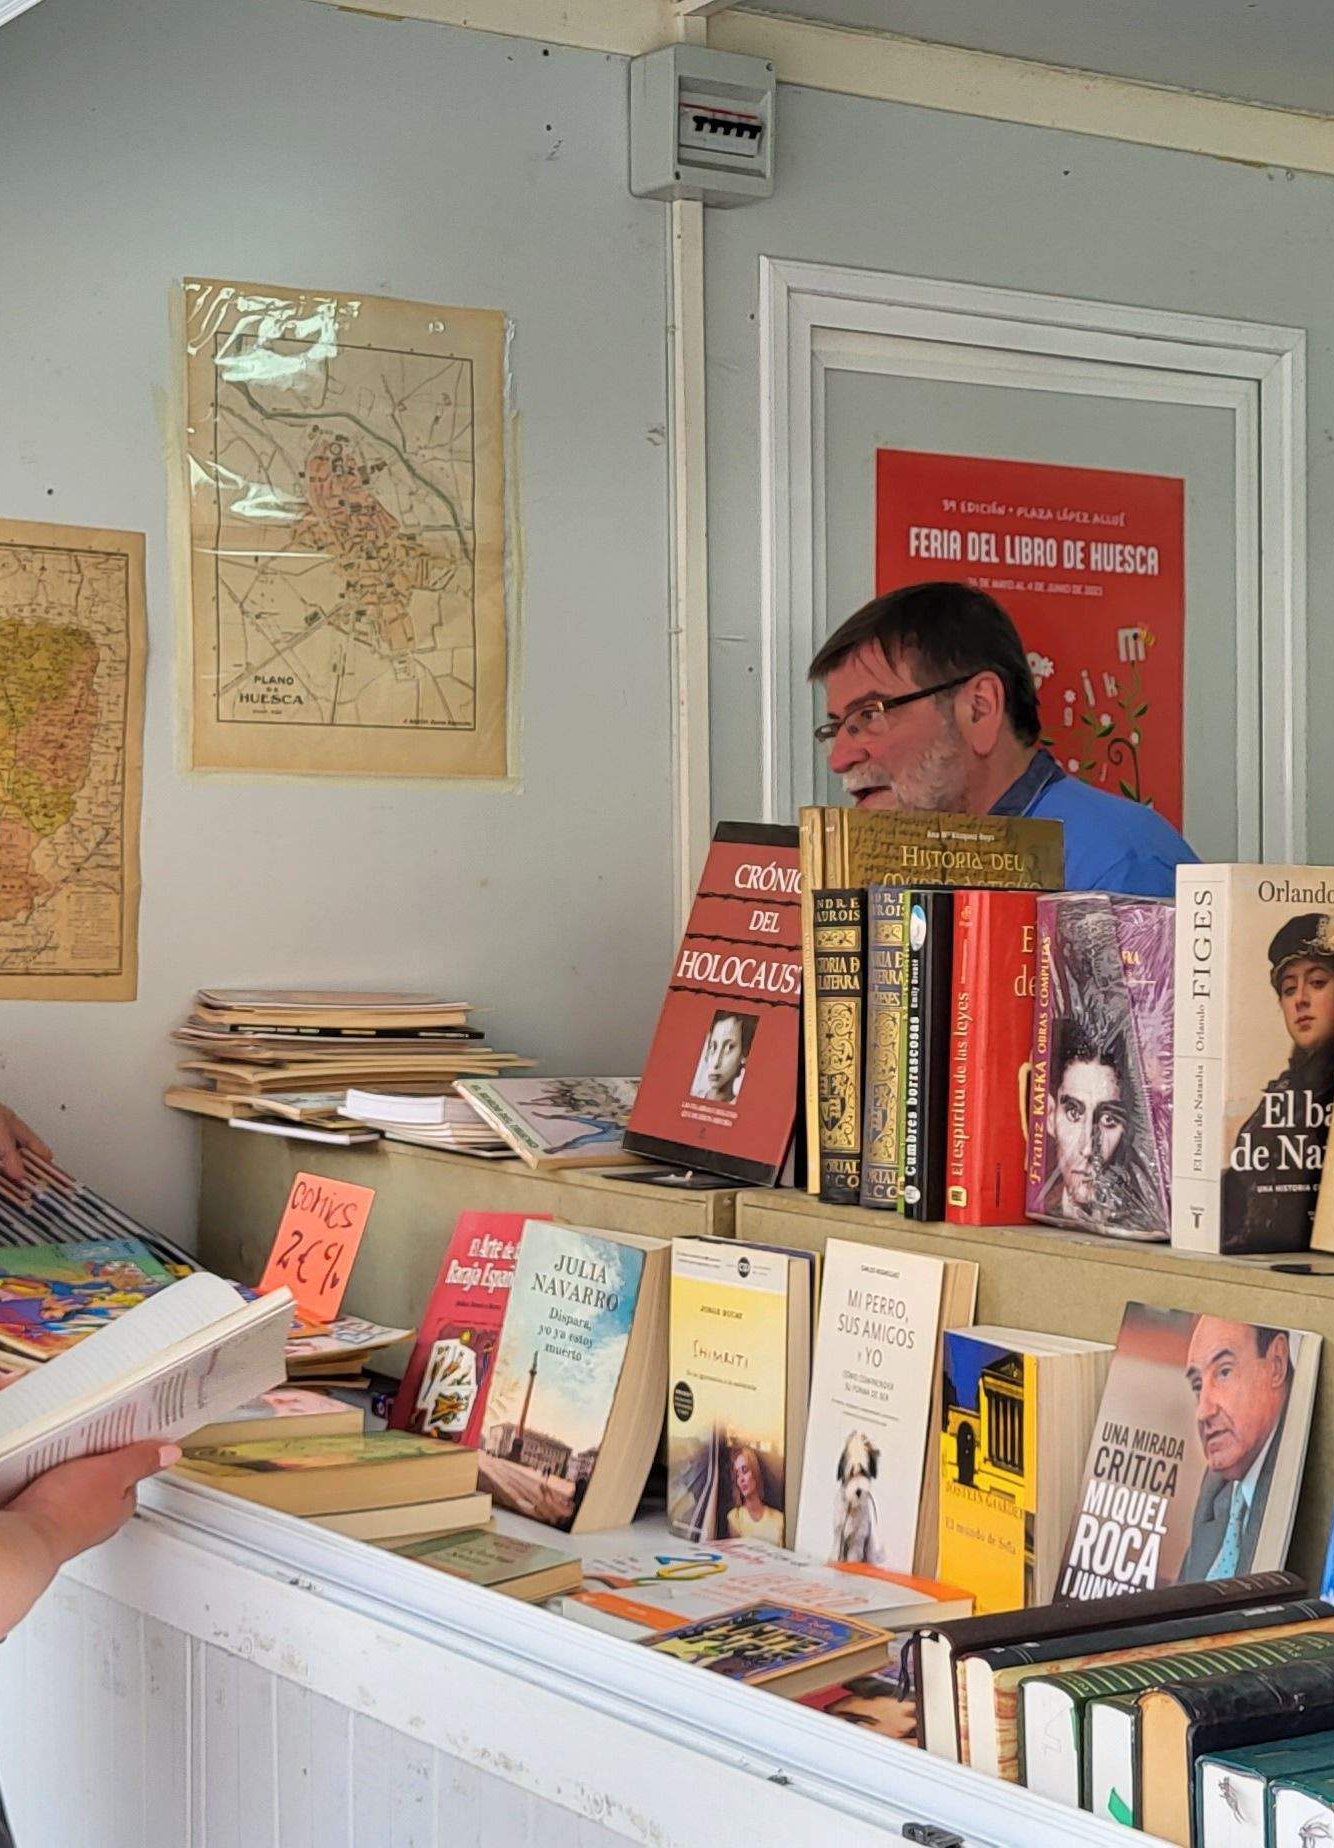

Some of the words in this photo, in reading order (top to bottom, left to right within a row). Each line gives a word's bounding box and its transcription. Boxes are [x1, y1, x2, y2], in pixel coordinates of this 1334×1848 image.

[960, 501, 1006, 516] EDICIÓN
[1017, 507, 1054, 520] PLAZA
[1056, 507, 1090, 524] LÓPEZ
[909, 526, 962, 560] FERIA
[967, 531, 1000, 564] DEL
[1004, 535, 1057, 568] LIBRO
[1063, 540, 1085, 570] DE
[1090, 542, 1159, 576] HUESCA
[254, 675, 295, 686] PLANO
[238, 693, 304, 705] HUESCA
[900, 845, 984, 870] HISTORIA
[991, 852, 1026, 873] DEL
[734, 861, 802, 894] CRÓNIC
[749, 910, 780, 933] DEL
[1193, 890, 1214, 999] FIGES
[910, 986, 920, 1008] Emily
[954, 992, 973, 1037] leyes
[1195, 1004, 1206, 1052] Orlando
[1037, 1012, 1049, 1054] OBRAS
[907, 1016, 920, 1105] borrascosas
[955, 1041, 968, 1061] las
[957, 1066, 967, 1084] de
[1032, 1061, 1048, 1115] KAFKA
[1194, 1065, 1205, 1110] Natasha
[1194, 1113, 1204, 1127] de
[1261, 1089, 1295, 1128] El
[904, 1111, 918, 1177] Cumbres
[1030, 1122, 1045, 1185] Franz
[1193, 1130, 1204, 1156] baile
[1229, 1133, 1270, 1171] de
[952, 1162, 964, 1177] El
[1193, 1160, 1203, 1172] El
[1257, 1184, 1274, 1193] UNA
[1275, 1184, 1311, 1193] HISTORIA
[480, 1233, 503, 1260] Arte
[502, 1240, 516, 1260] de
[445, 1258, 482, 1292] Baraja
[554, 1254, 608, 1285] JULIA
[531, 1272, 619, 1313] NAVARRO
[847, 1289, 862, 1308] MI
[865, 1293, 909, 1324] PERRO,
[548, 1306, 592, 1331] Dispara,
[837, 1313, 860, 1336] SUS
[862, 1319, 915, 1350] AMIGOS
[537, 1323, 553, 1337] yo
[554, 1327, 568, 1342] ya
[569, 1332, 594, 1349] estoy
[544, 1342, 582, 1361] muerto
[865, 1346, 883, 1368] YO
[1102, 1421, 1128, 1447] UNA
[1132, 1430, 1185, 1461] MIRADA
[1082, 1479, 1168, 1535] MIQUEL
[1069, 1513, 1162, 1591] ROCA
